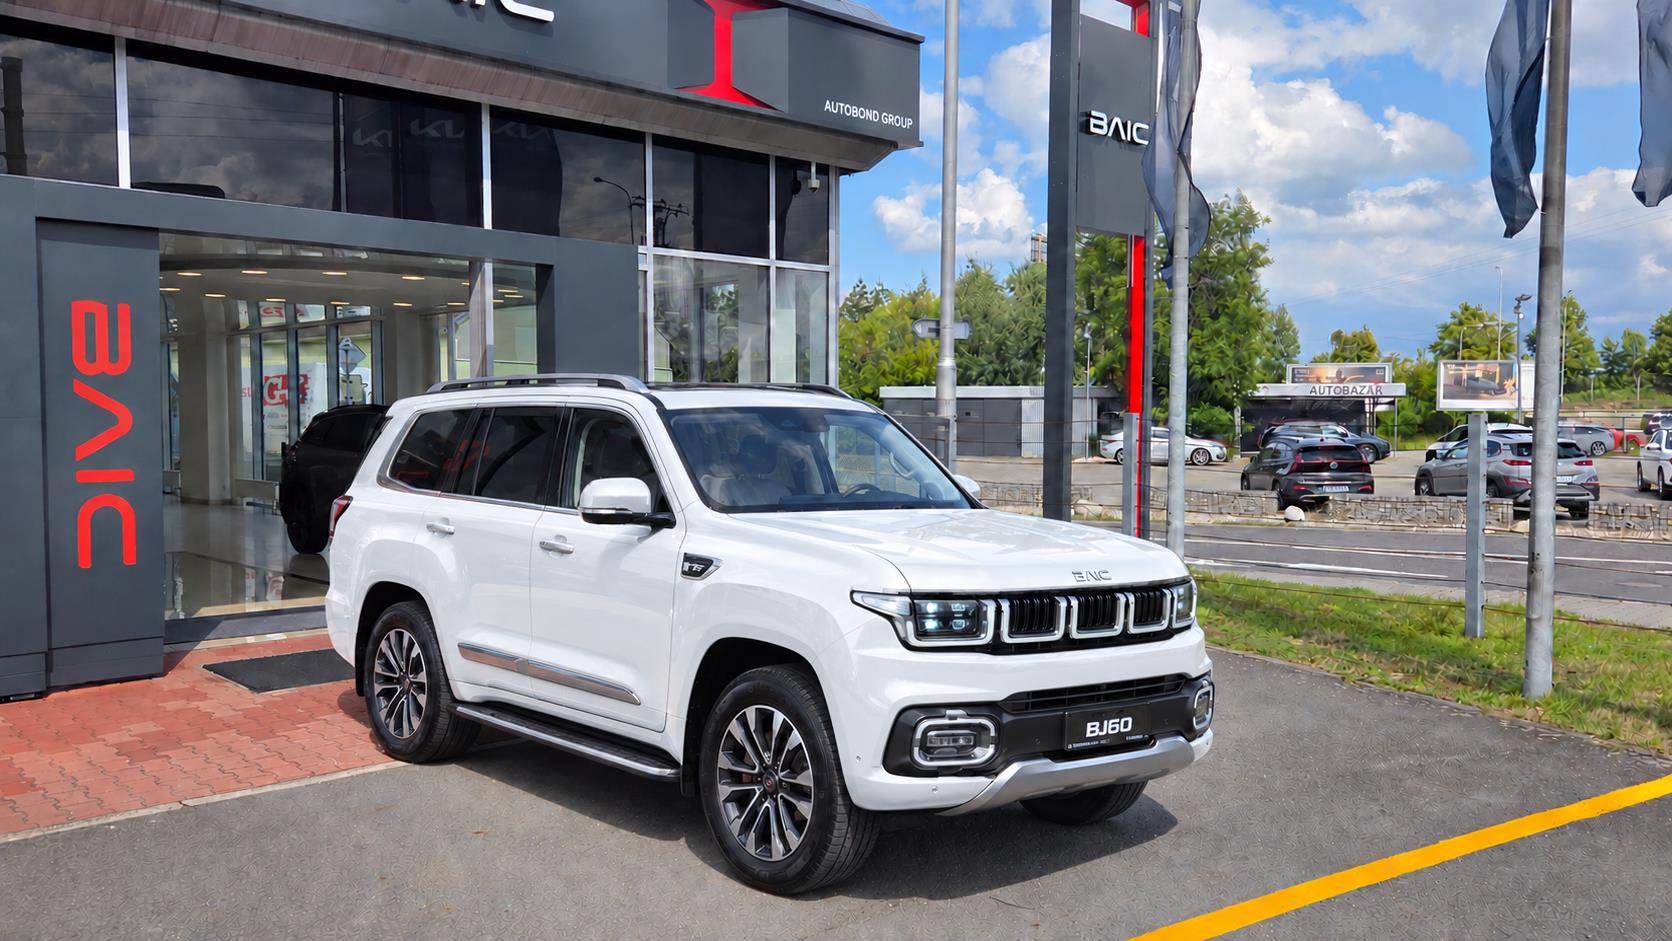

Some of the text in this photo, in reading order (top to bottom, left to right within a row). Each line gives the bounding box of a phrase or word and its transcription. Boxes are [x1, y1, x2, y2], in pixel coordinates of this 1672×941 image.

[824, 100, 913, 129] AUTOBOND GROUP
[1089, 110, 1150, 145] BAIC
[1309, 385, 1383, 396] AUTOBAZAR
[71, 300, 137, 569] BAIC
[1085, 716, 1133, 738] BJ60
